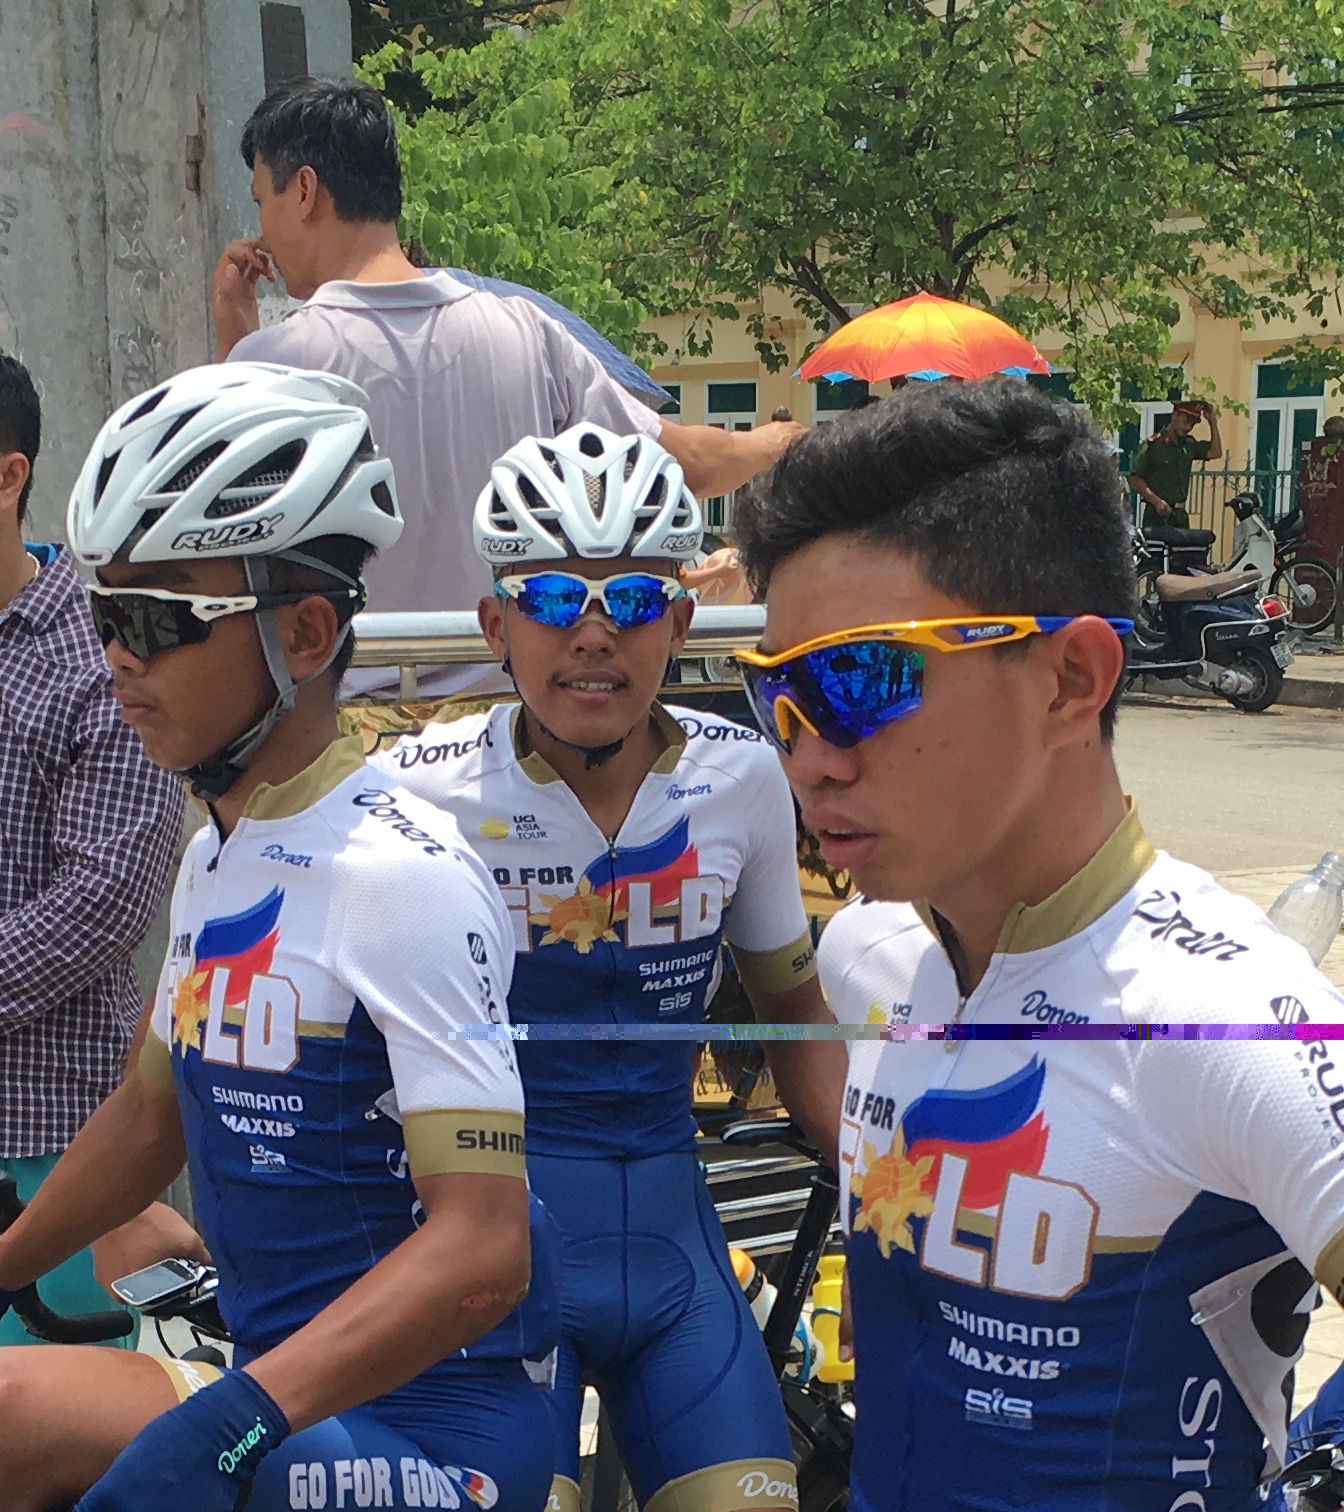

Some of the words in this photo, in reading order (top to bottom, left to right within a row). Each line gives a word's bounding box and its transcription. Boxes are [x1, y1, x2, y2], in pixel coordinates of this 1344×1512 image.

[170, 512, 285, 550] RUDY
[481, 537, 534, 553] RUDY
[966, 624, 1006, 637] RUDY
[512, 814, 536, 824] UCI
[515, 823, 541, 832] ASIA
[517, 830, 548, 840] TOUR
[519, 865, 575, 886] FOR
[638, 949, 714, 977] SHIMANO
[642, 967, 707, 993] MAXXIS
[212, 1085, 305, 1113] SHIMANO
[859, 1090, 896, 1131] FOR
[220, 1114, 296, 1137] MAXXIS
[455, 1129, 526, 1156] SHIM
[938, 1300, 1081, 1350] SHIMANO
[947, 1337, 1062, 1381] MAXXIS
[216, 1416, 270, 1476] Donen
[288, 1462, 327, 1511] GO
[334, 1456, 394, 1509] FOR
[736, 1470, 799, 1504] Done
